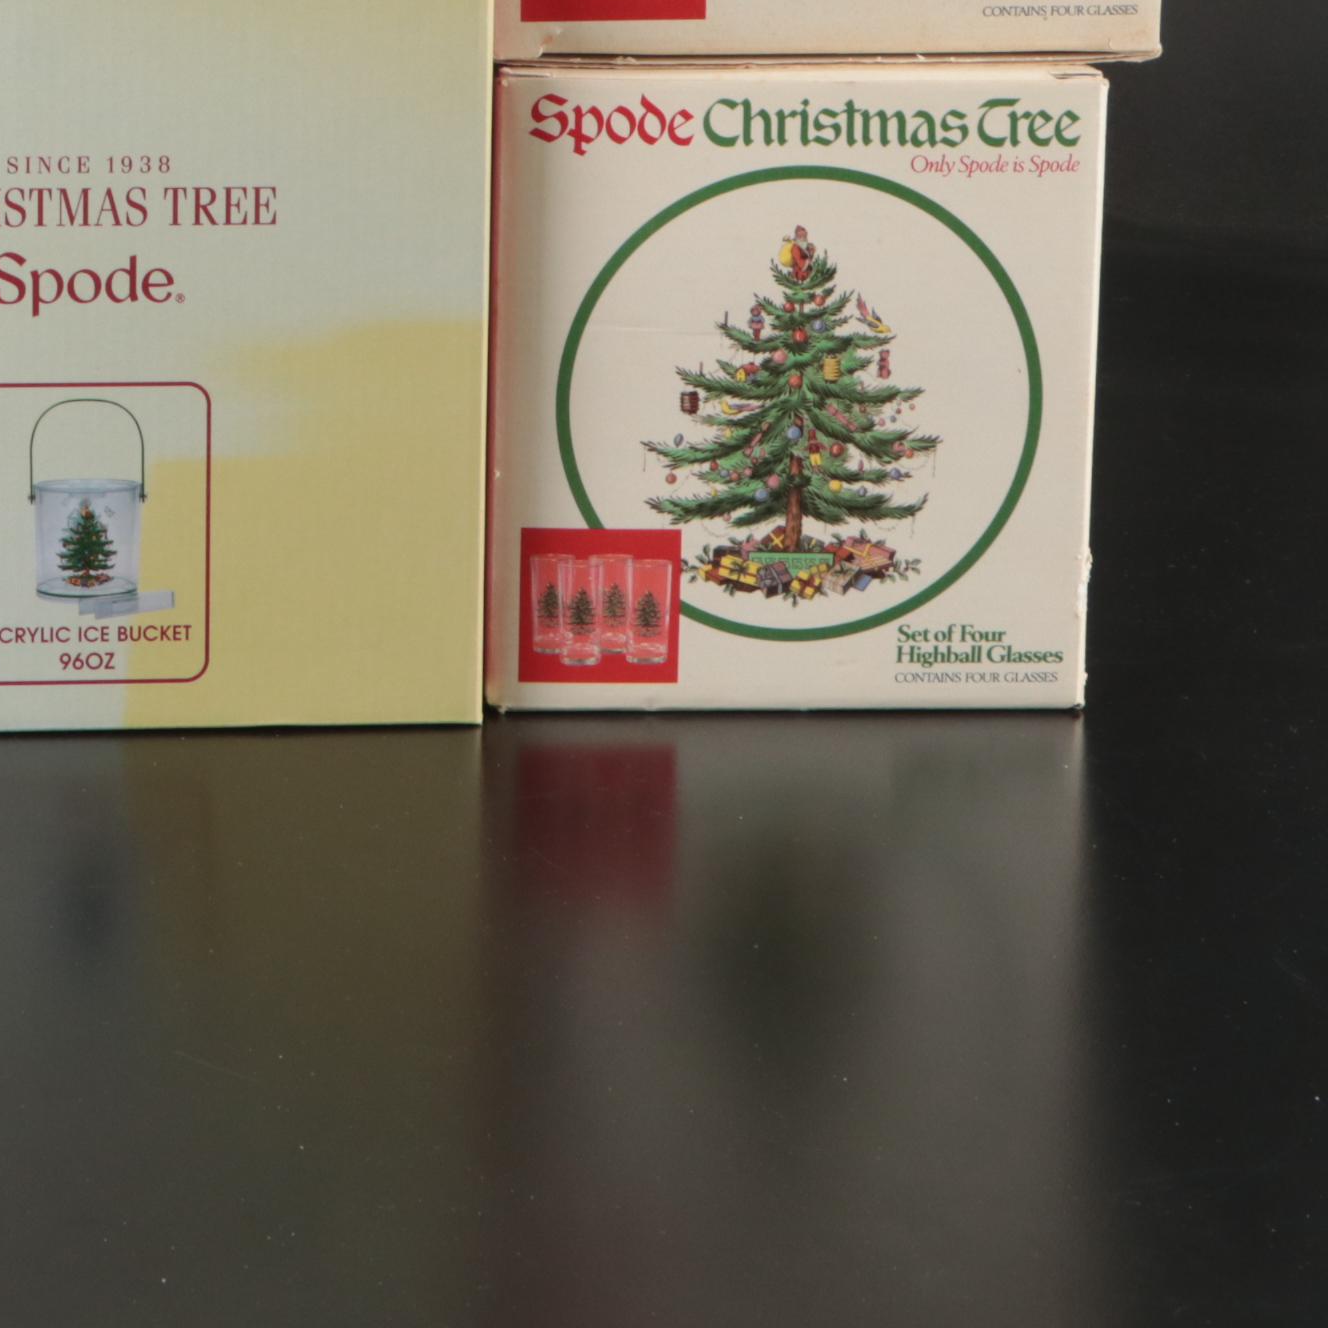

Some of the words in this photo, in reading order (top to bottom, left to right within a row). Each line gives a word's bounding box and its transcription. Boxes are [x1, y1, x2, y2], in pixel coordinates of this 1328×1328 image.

[982, 5, 1047, 17] CONTAINS
[1051, 5, 1085, 16] FOUR
[1087, 4, 1138, 16] GLASSES
[529, 93, 695, 156] Spode
[702, 97, 969, 148] Christmas
[976, 97, 1081, 148] Tree
[7, 155, 91, 174] SINCE
[107, 155, 172, 174] 1938
[911, 154, 955, 177] Only
[959, 154, 1009, 178] Spode
[1013, 156, 1025, 173] is
[1029, 153, 1080, 178] Spode
[163, 186, 277, 226] TREE
[78, 625, 110, 643] ICE
[117, 624, 192, 642] BUCKET
[897, 624, 930, 643] Set
[934, 624, 956, 643] of
[960, 624, 1006, 643] Four
[896, 645, 982, 668] Highball
[986, 645, 1064, 663] Glasses
[895, 672, 961, 683] CONTAINS
[965, 672, 999, 683] FOUR
[1004, 672, 1058, 683] GLASSES
